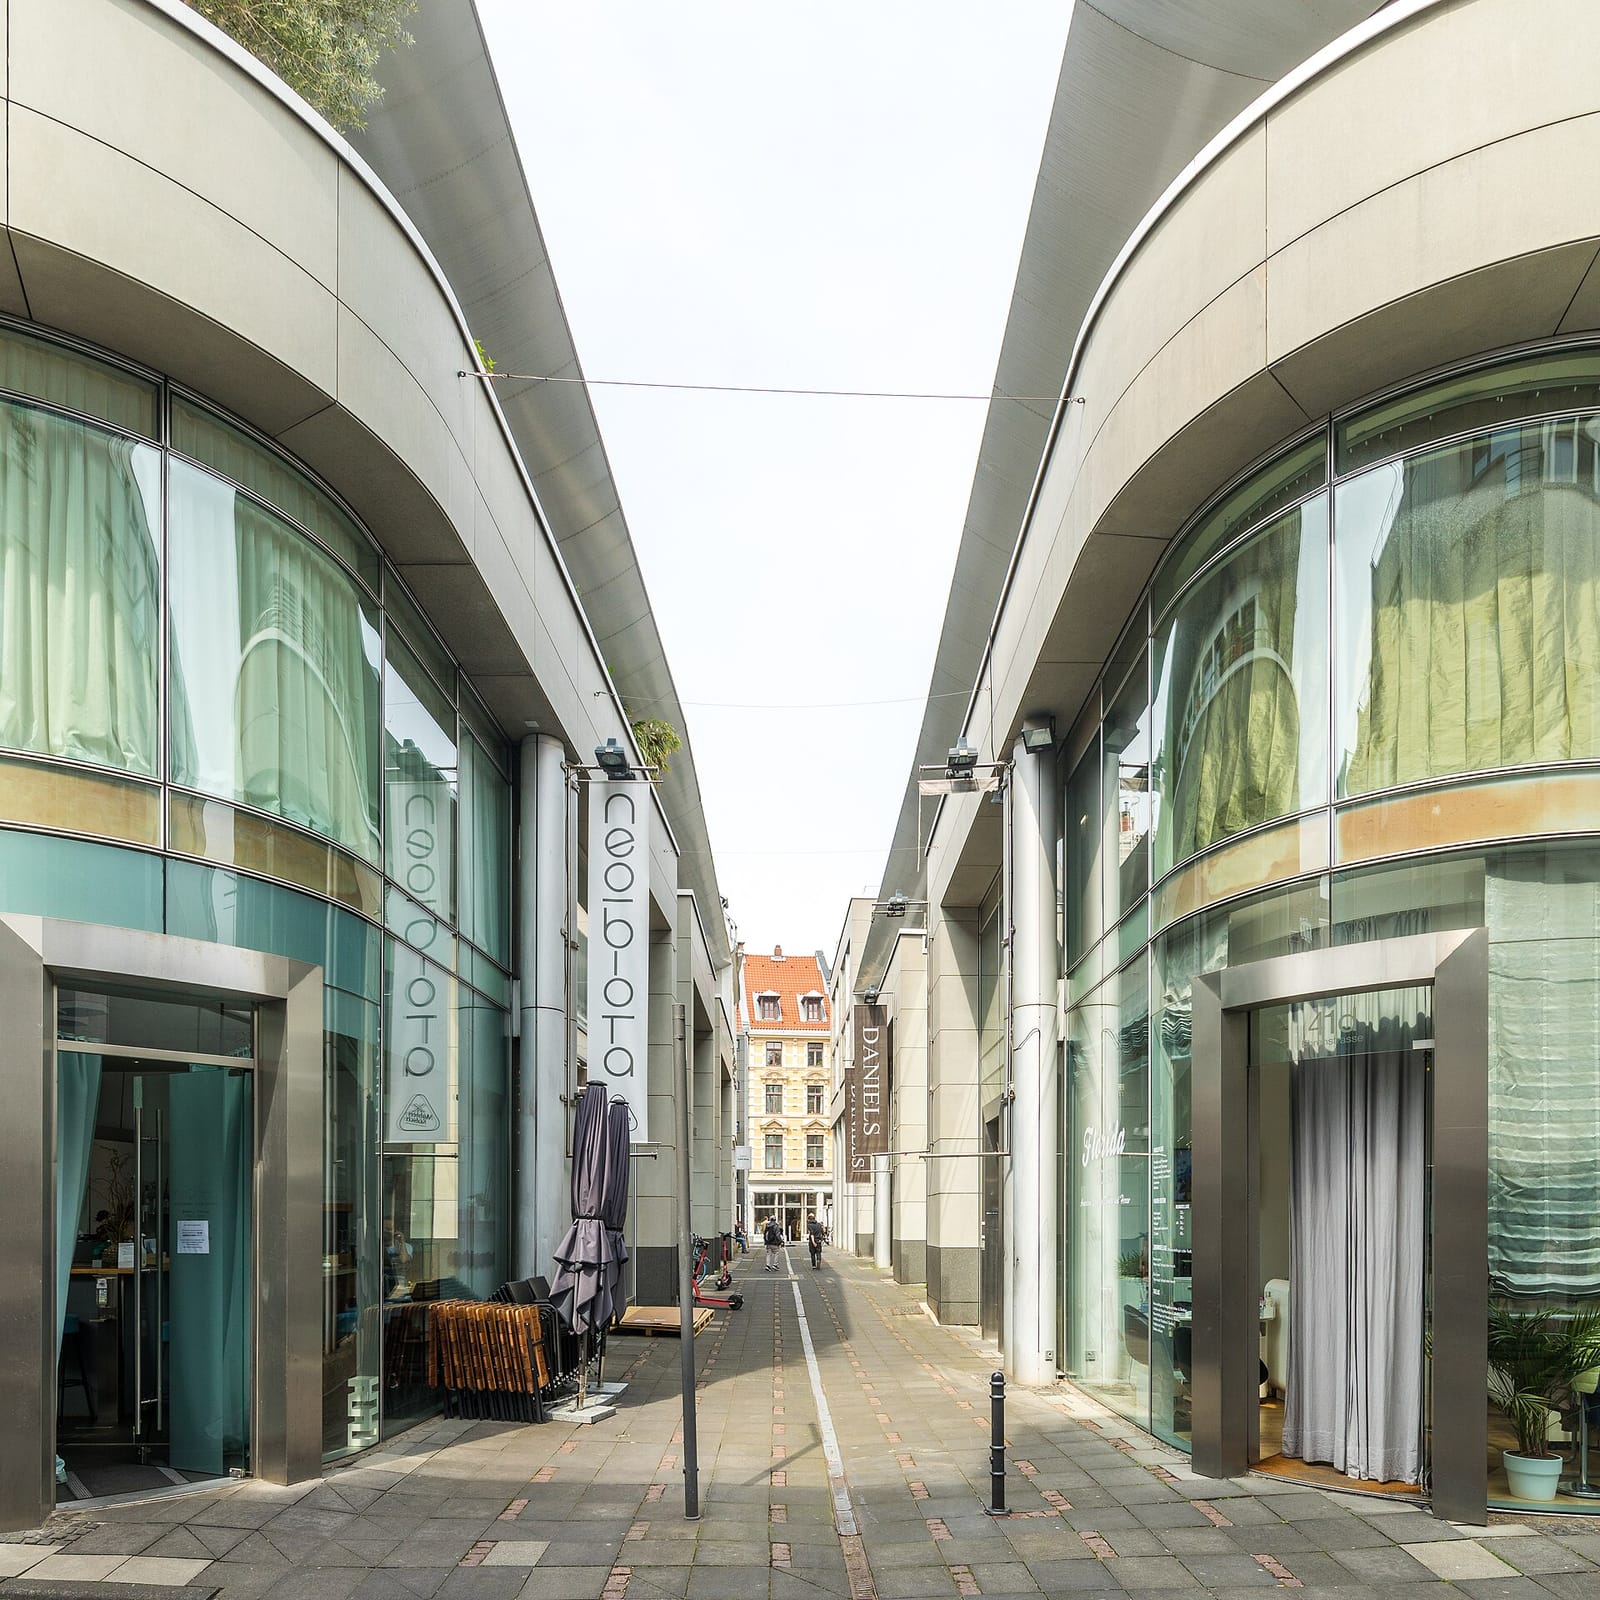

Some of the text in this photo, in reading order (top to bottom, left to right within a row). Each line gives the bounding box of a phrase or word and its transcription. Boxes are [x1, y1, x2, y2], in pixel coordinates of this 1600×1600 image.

[1302, 1034, 1364, 1049] Ernstasse
[862, 1026, 881, 1137] DANIELS
[1082, 1120, 1126, 1168] Florida
